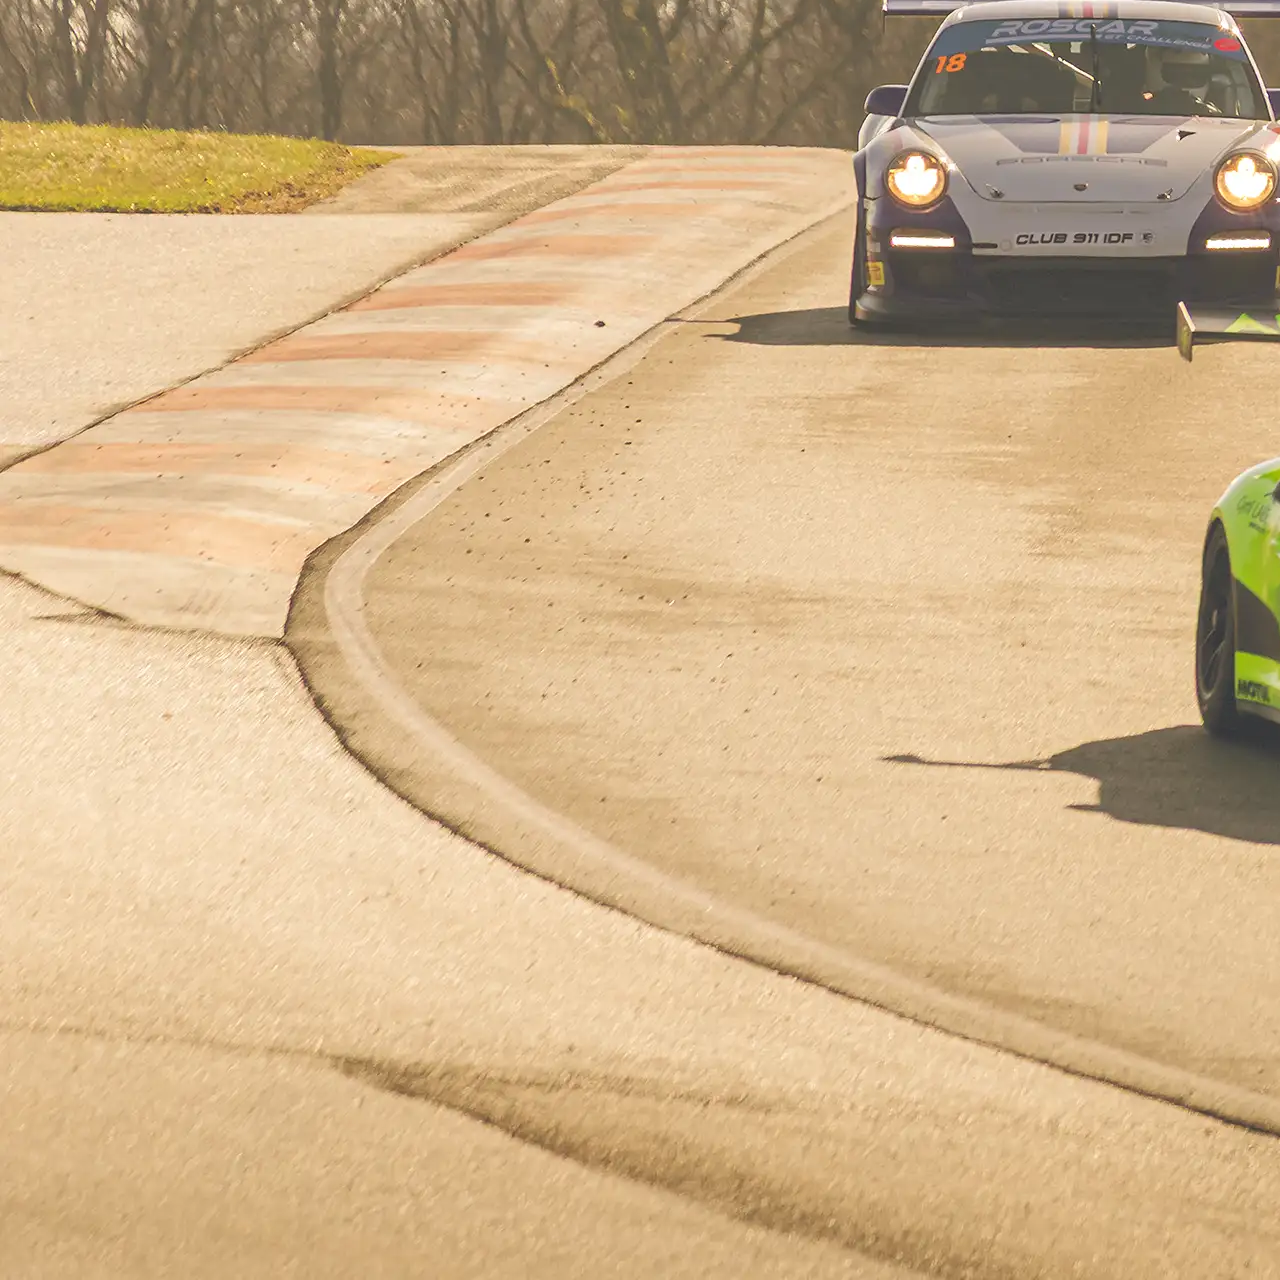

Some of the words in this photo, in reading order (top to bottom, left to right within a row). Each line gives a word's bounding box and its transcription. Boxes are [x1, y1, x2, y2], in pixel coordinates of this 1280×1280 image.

[992, 19, 1158, 37] ROSCAR
[935, 53, 967, 74] 18
[1015, 232, 1068, 245] CLUB
[1072, 232, 1099, 245] 911
[1103, 232, 1134, 244] IDF
